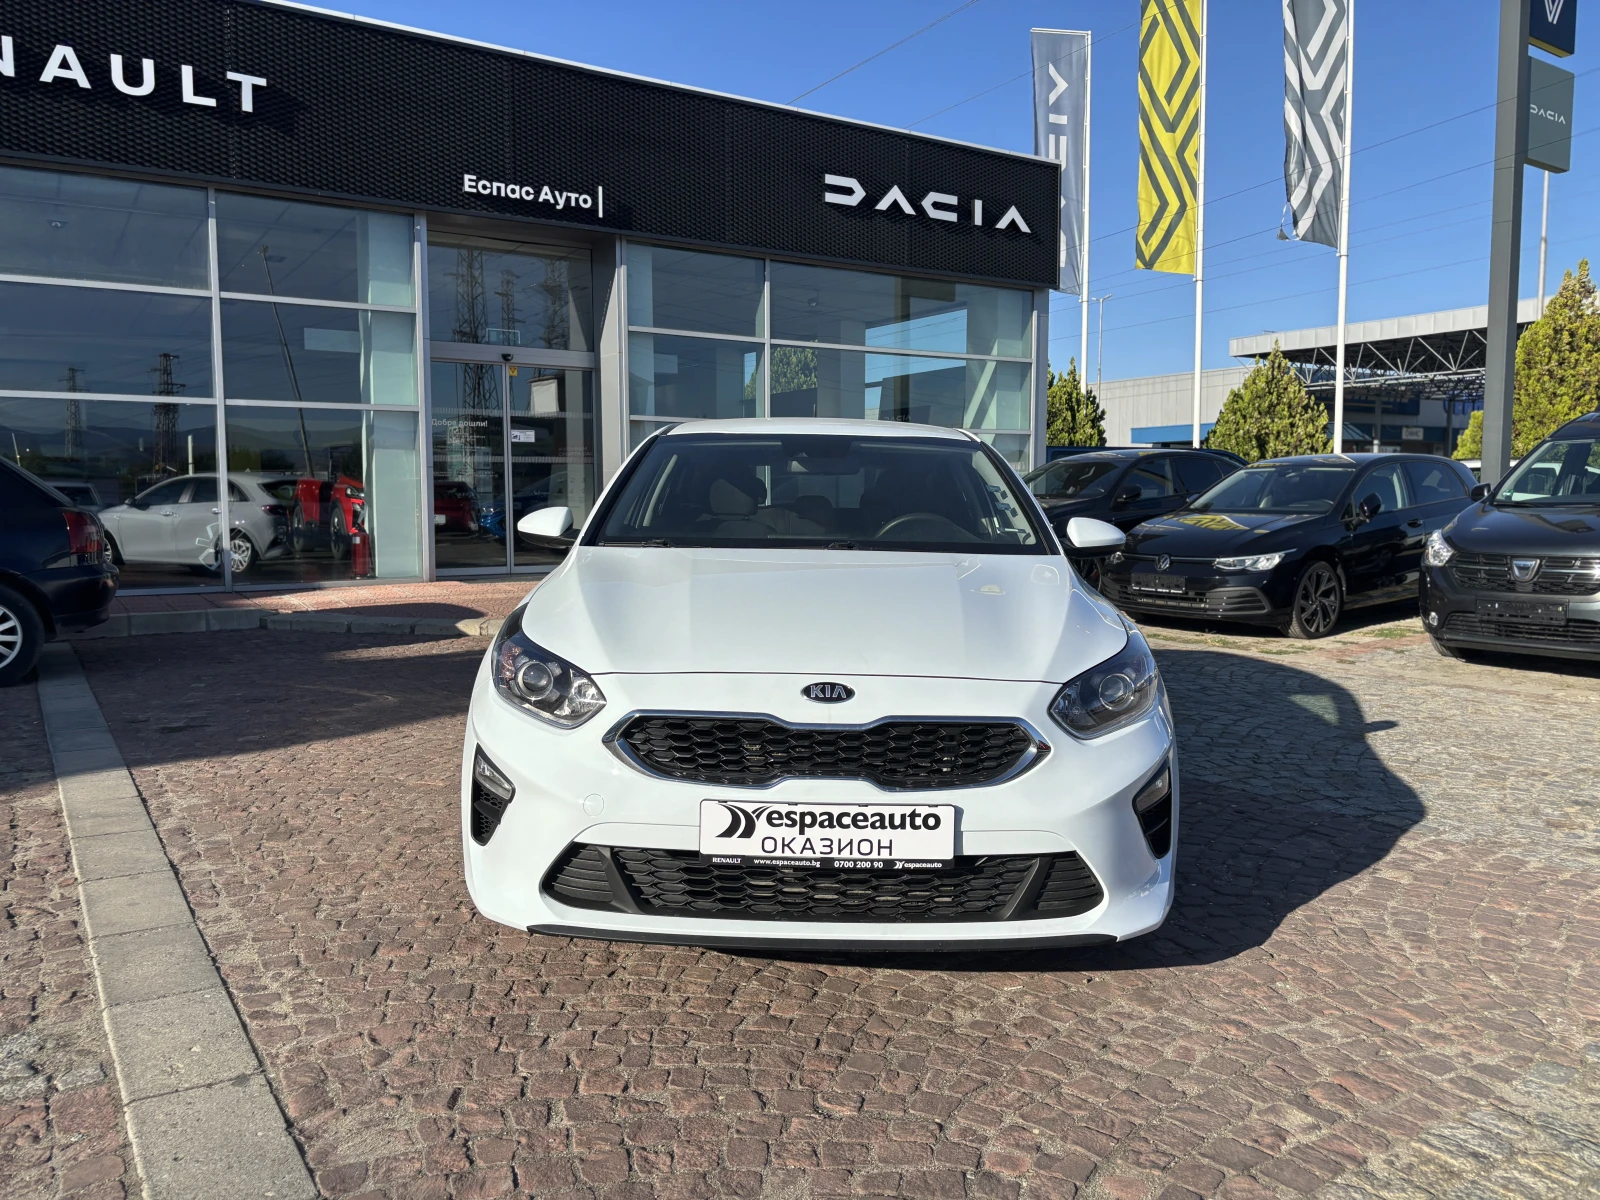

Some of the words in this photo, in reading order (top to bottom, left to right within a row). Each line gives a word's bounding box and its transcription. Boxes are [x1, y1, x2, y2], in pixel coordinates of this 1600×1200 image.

[1530, 104, 1566, 124] DACIA
[463, 174, 535, 201] Еспас
[538, 186, 592, 210] Ауто
[824, 174, 1031, 233] DACIA
[458, 420, 488, 428] дошли!
[810, 684, 847, 698] KIA
[765, 807, 942, 836] espaceauto
[761, 836, 893, 857] ОКАЗИОН
[753, 857, 821, 868] www.espaceauto.bg
[834, 860, 854, 868] 0700
[856, 861, 872, 869] 200
[903, 862, 943, 870] espaceauto
